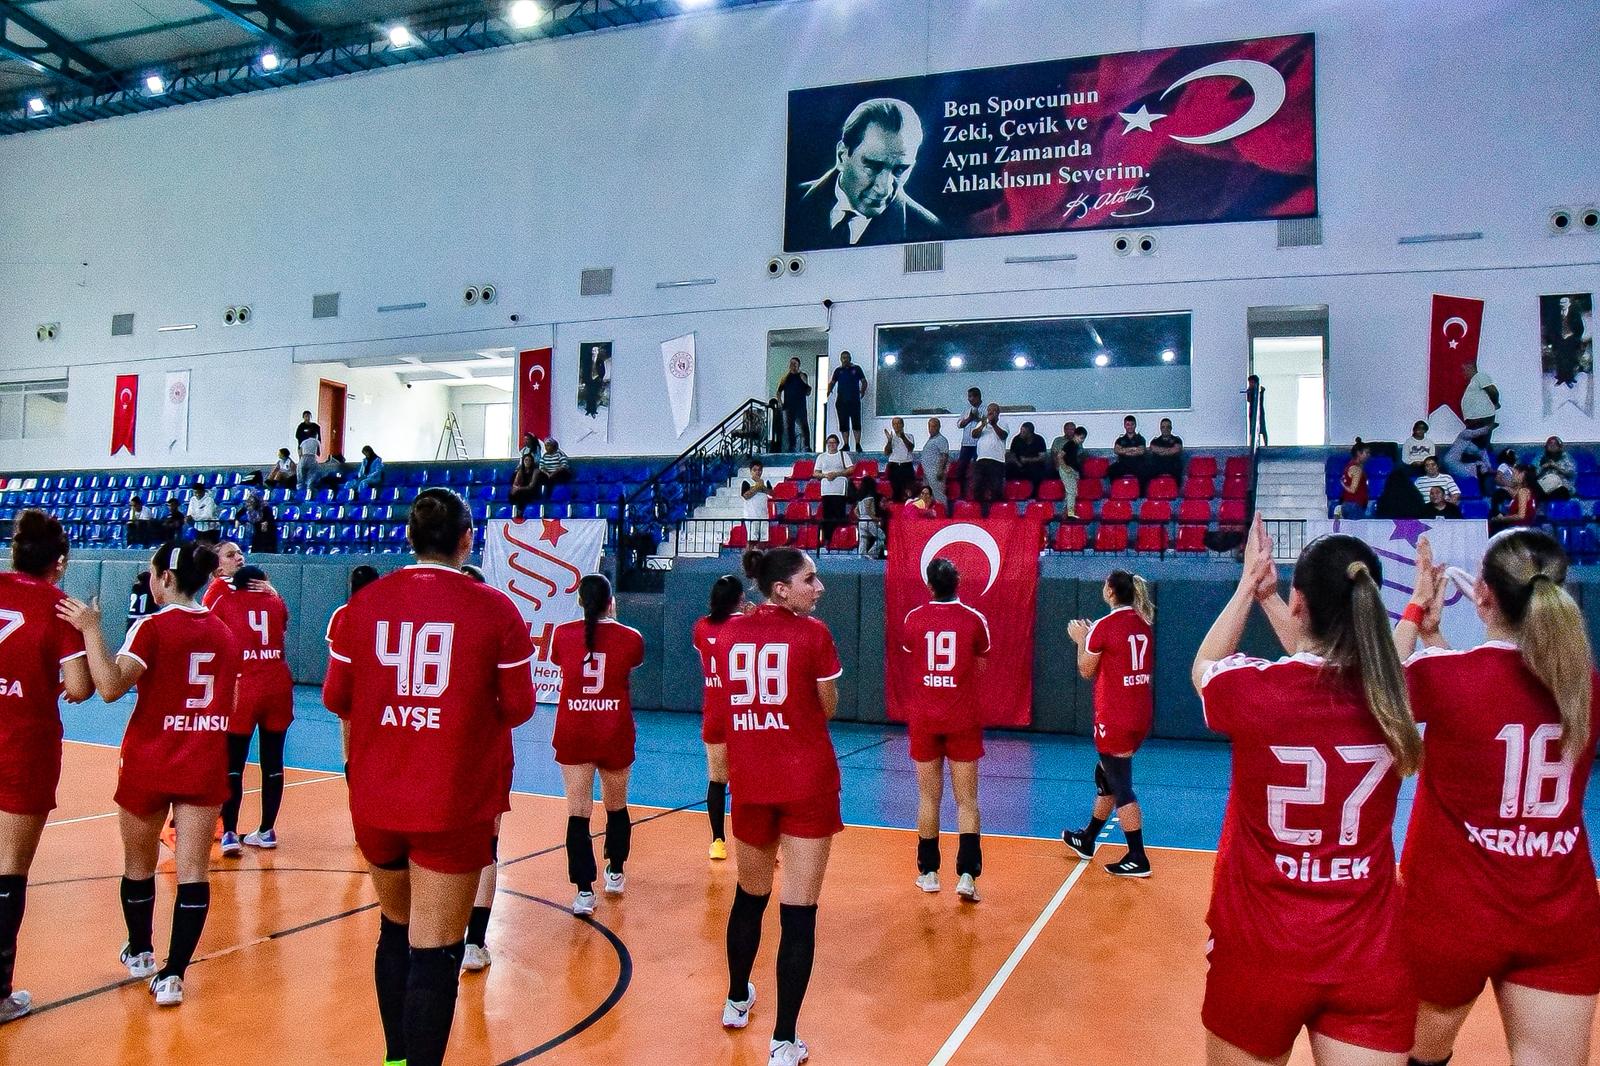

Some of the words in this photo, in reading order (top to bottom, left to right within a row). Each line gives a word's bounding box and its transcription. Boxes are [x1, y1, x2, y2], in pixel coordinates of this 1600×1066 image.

[943, 101, 980, 118] Ben
[987, 90, 1099, 117] Sporcunun
[943, 122, 993, 143] Zeki,
[1000, 116, 1059, 141] Çevik
[1066, 117, 1088, 131] ve
[942, 150, 988, 171] Aynı
[994, 140, 1092, 164] Zamanda
[942, 171, 1051, 194] Ahlaklısını
[1059, 162, 1150, 184] Severim.
[130, 593, 148, 613] 21
[248, 610, 269, 645] 4
[375, 621, 454, 697] 48
[924, 631, 957, 671] 19
[1127, 633, 1149, 671] 17
[186, 652, 216, 709] 5
[582, 652, 607, 694] 9
[729, 643, 789, 706] 98
[923, 673, 957, 688] SİBEL
[380, 705, 441, 731] AYŞE
[567, 699, 621, 711] BOZKURT
[733, 708, 790, 731] HİLAL
[163, 713, 229, 731] PELİNSU
[1267, 744, 1395, 846] 27
[1275, 852, 1371, 883] DİLEK
